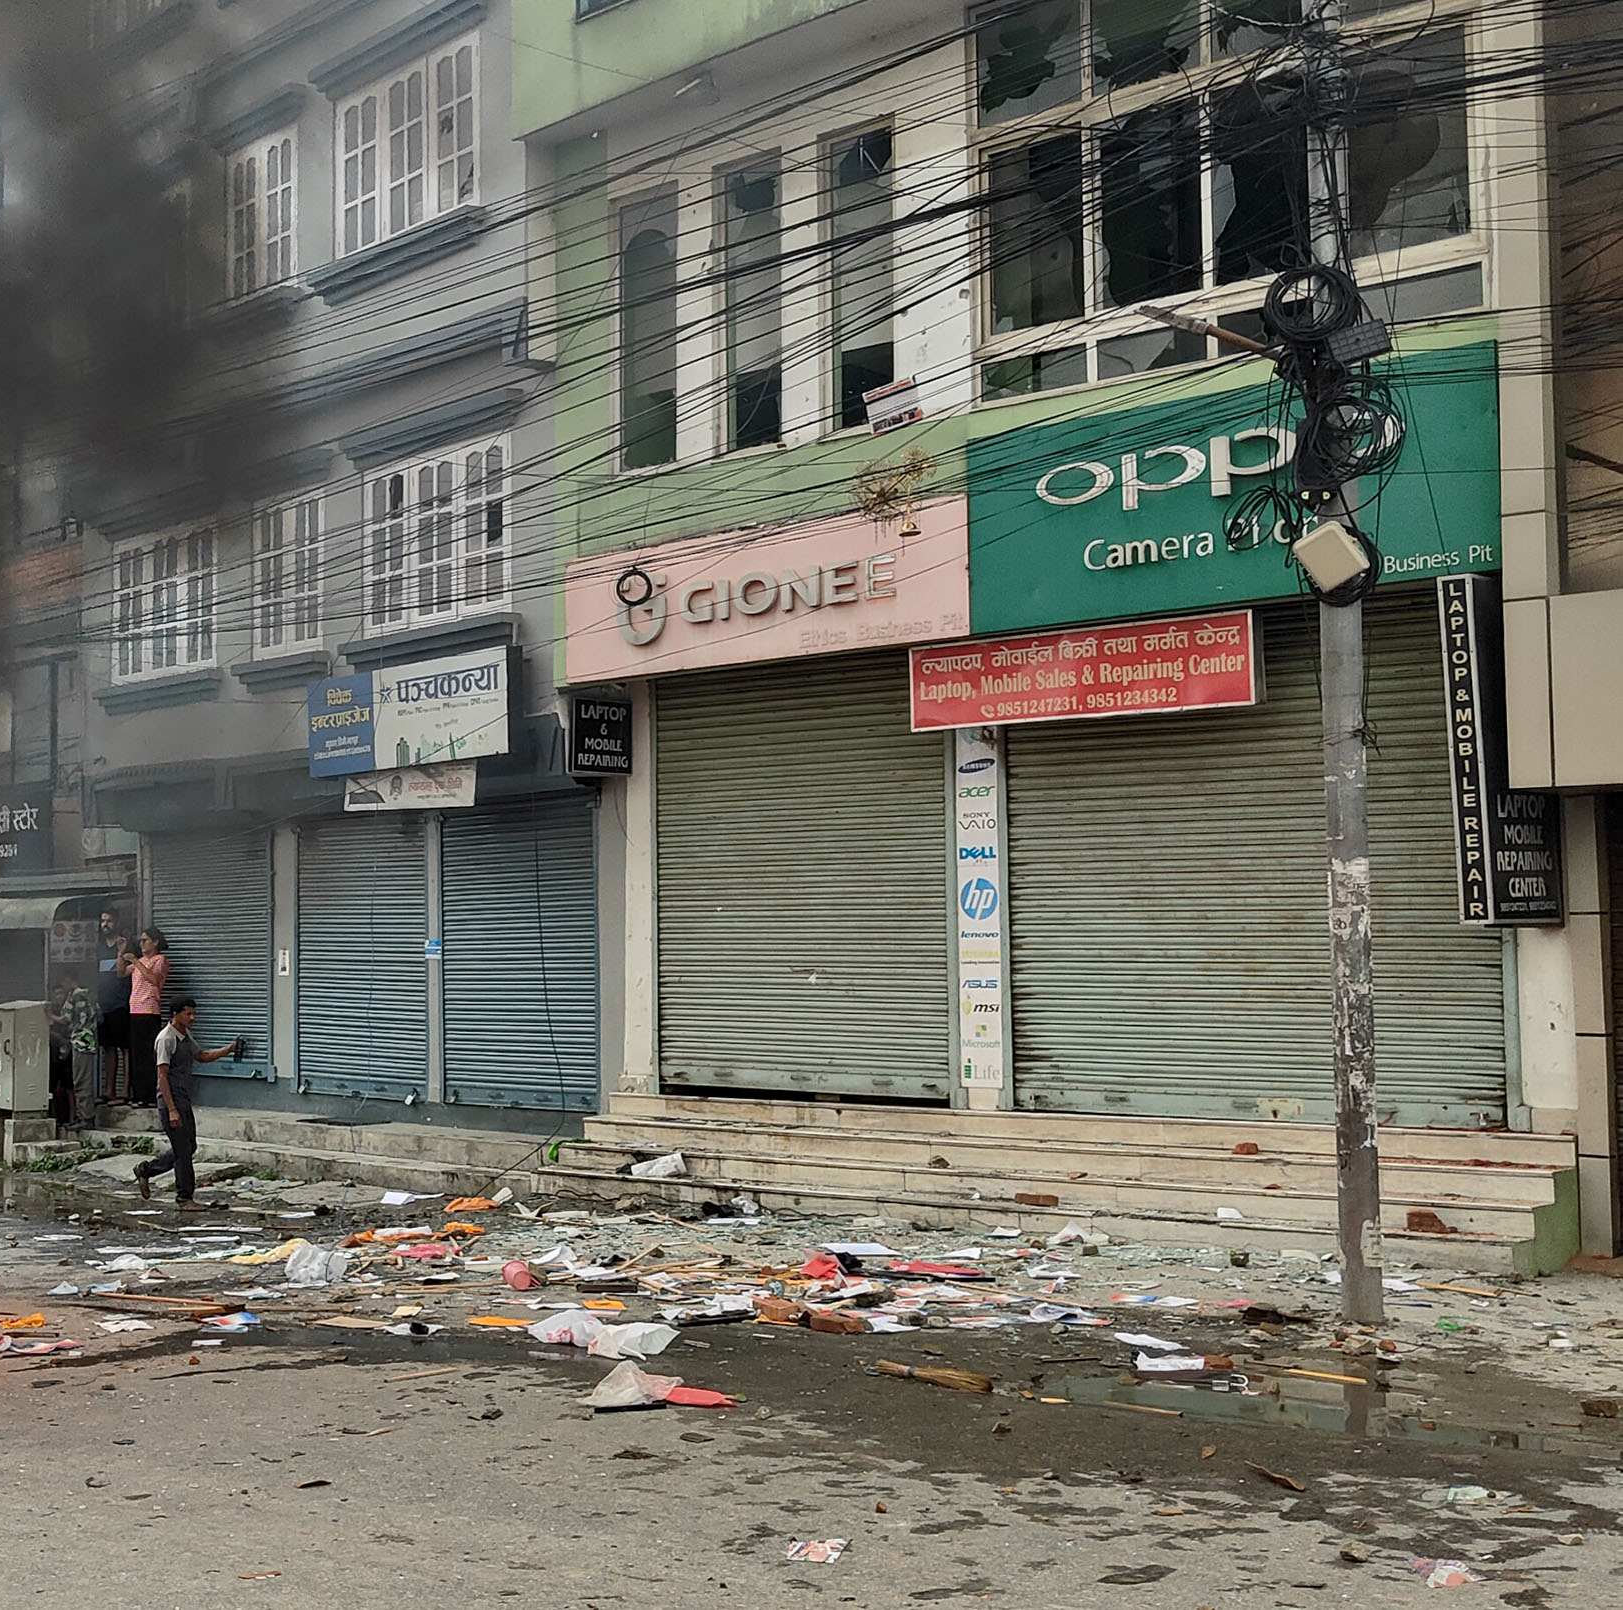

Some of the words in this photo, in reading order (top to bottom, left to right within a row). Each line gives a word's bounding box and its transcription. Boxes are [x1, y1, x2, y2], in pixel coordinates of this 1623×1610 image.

[1083, 531, 1214, 571] Camera
[1384, 550, 1460, 574] Business
[1468, 545, 1493, 564] Pit
[680, 553, 897, 623] GIONEE
[1103, 636, 1137, 656] तथा
[1194, 623, 1241, 646] केन्द्र
[1448, 583, 1468, 681] LAPTOP
[919, 679, 976, 703] Laptop,
[981, 671, 1032, 695] Mobile
[1035, 667, 1077, 691] Sales
[1081, 664, 1095, 686] &
[1099, 657, 1185, 686] Repairing
[1188, 652, 1246, 676] Center
[997, 695, 1083, 717] 9851247231,
[1086, 687, 1178, 709] 9851234342
[1455, 688, 1470, 702] &
[581, 703, 627, 722] LAPTOP
[584, 737, 623, 752] MOBILE
[577, 752, 629, 768] REPAIRING
[1455, 707, 1477, 808] MOBILE
[958, 786, 995, 798] acer
[1496, 794, 1546, 819] LAPTOP
[958, 818, 996, 830] VAIO
[1503, 824, 1544, 845] MOBILE
[959, 846, 997, 860] DELL
[1496, 851, 1553, 871] REPAIRING
[1463, 816, 1485, 917] REPAIR
[1508, 877, 1546, 898] CENTER
[964, 878, 995, 920] hp
[961, 930, 999, 939] lenovo
[962, 979, 998, 989] ASUS
[973, 1003, 999, 1012] msi
[962, 1039, 1000, 1049] Microsoft
